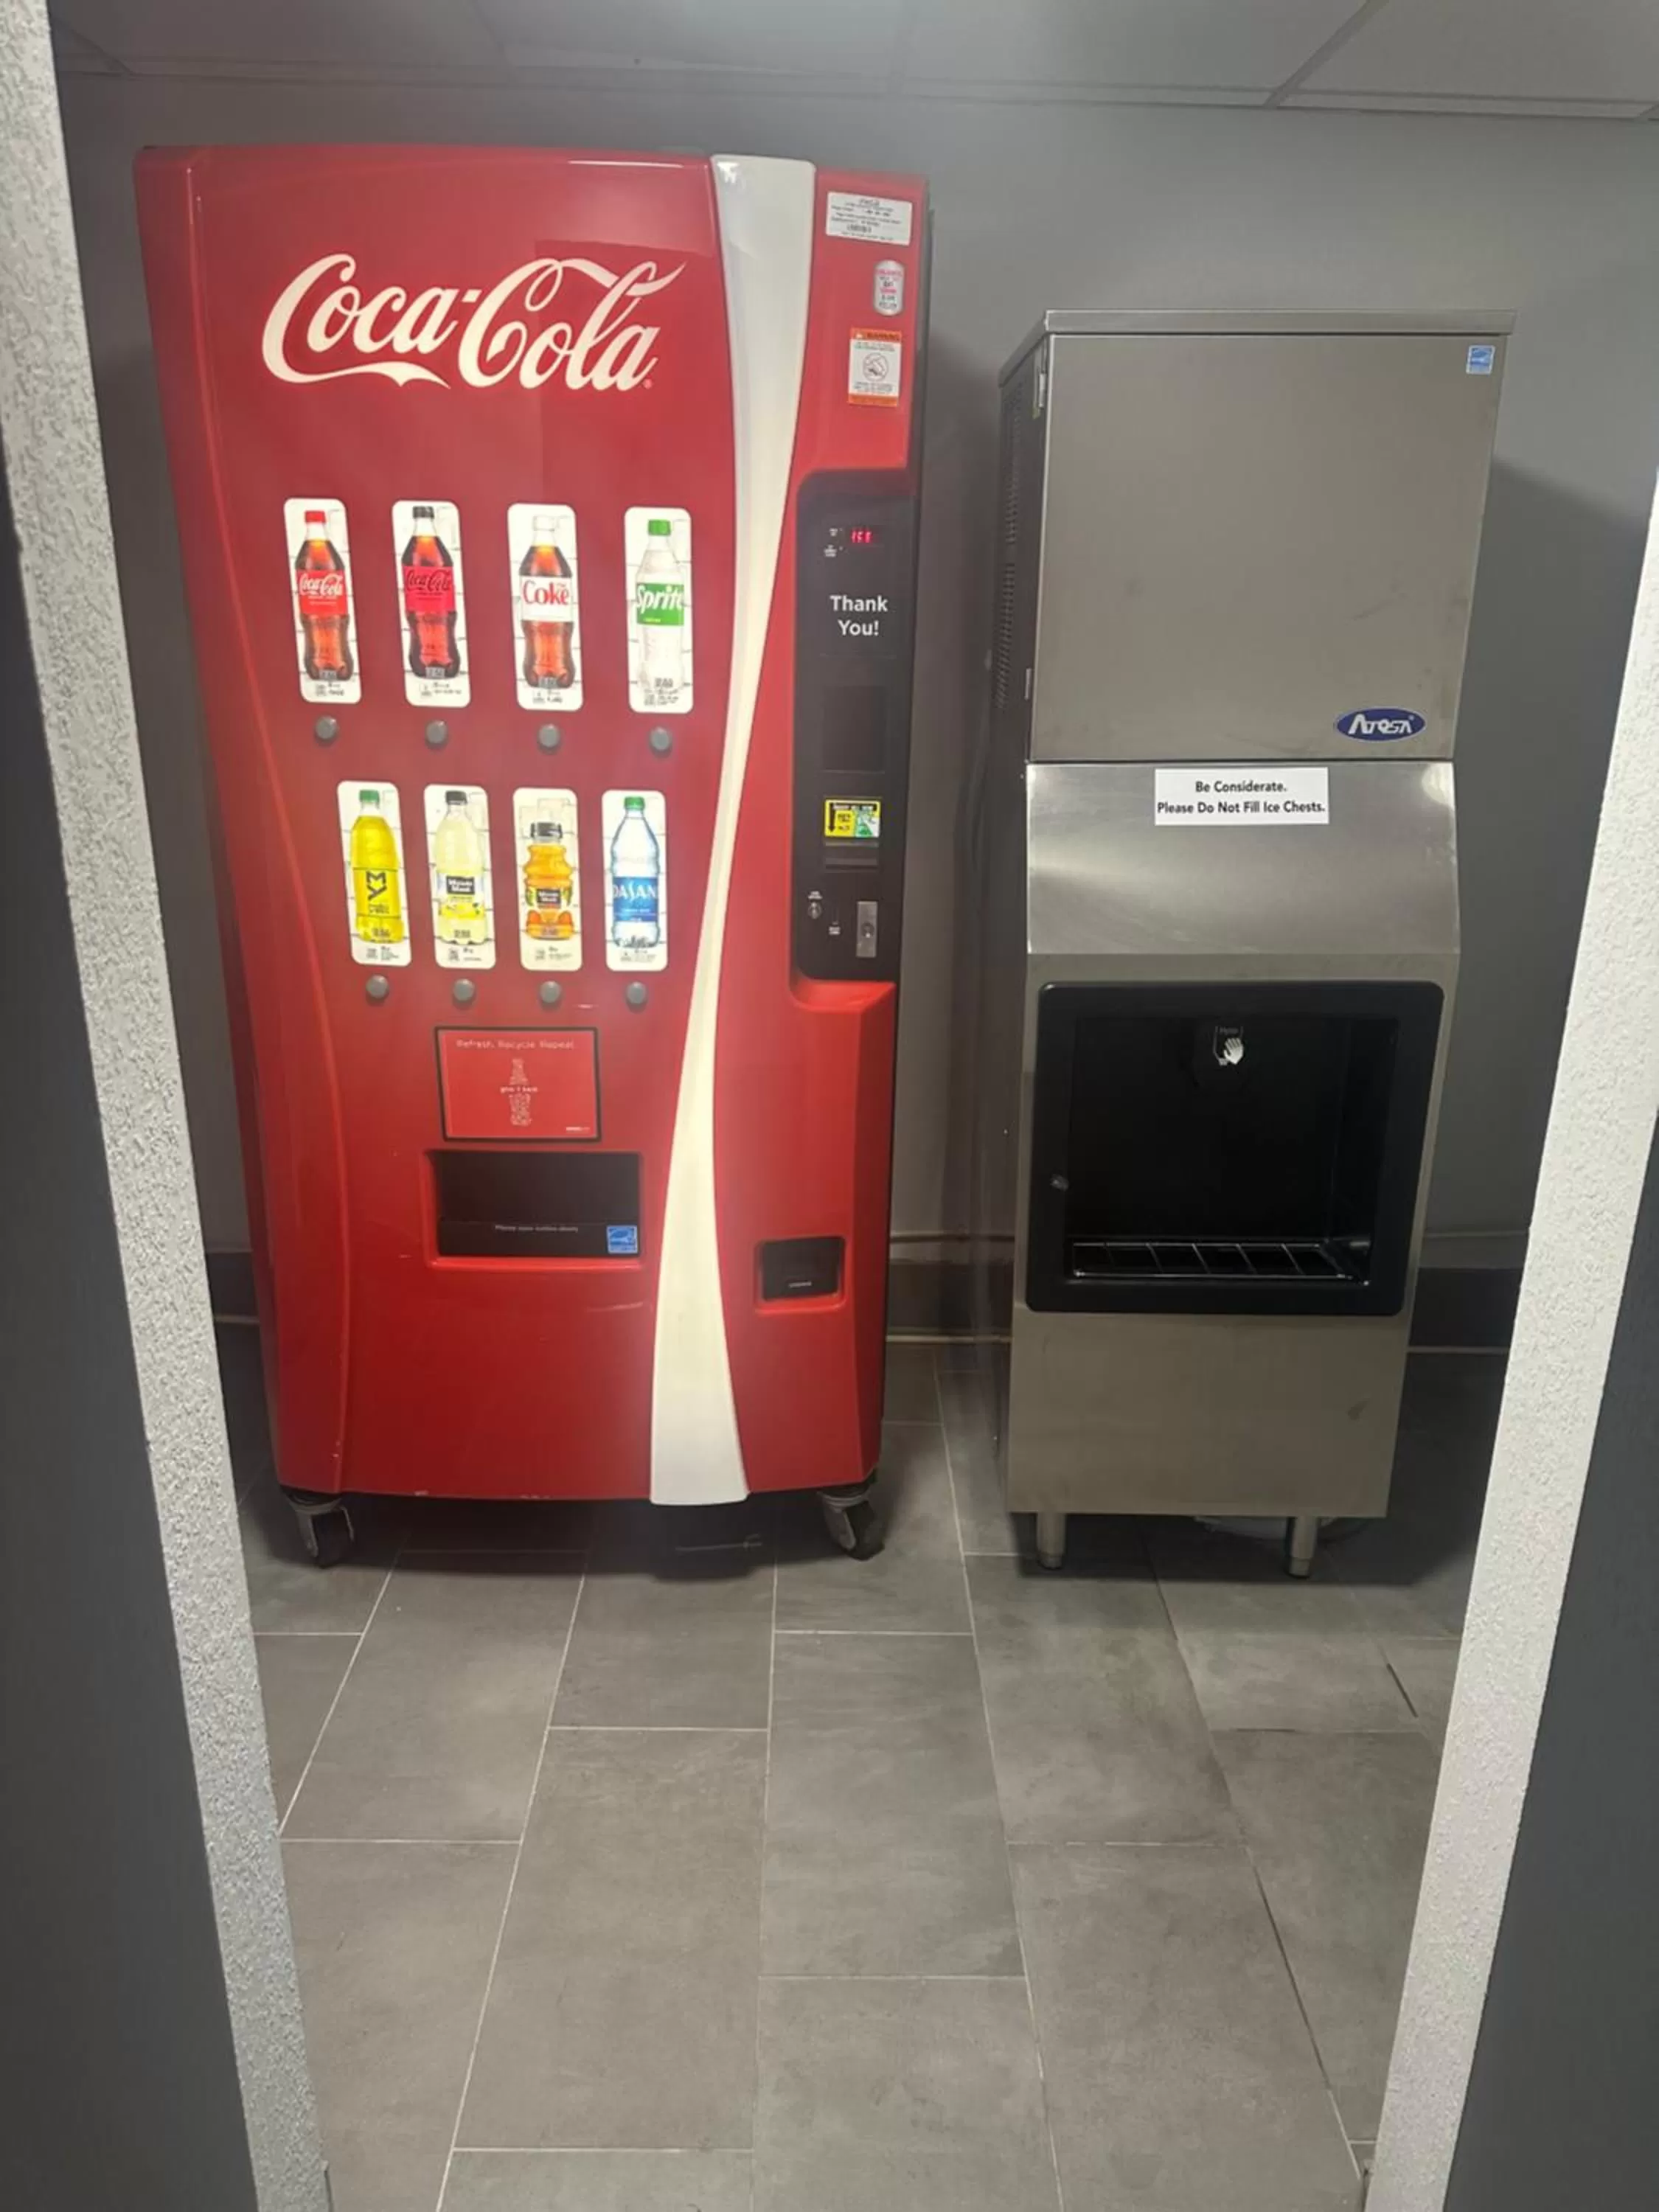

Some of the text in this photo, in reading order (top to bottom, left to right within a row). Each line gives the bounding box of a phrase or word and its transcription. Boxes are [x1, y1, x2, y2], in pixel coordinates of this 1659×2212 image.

[262, 253, 687, 391] Coca-Cola
[523, 580, 570, 605] Coke
[830, 594, 888, 611] Thank
[838, 619, 879, 636] You!
[1195, 780, 1287, 793] Be Considerate.
[1157, 800, 1325, 813] Please Do Not Fill Ice Chests.
